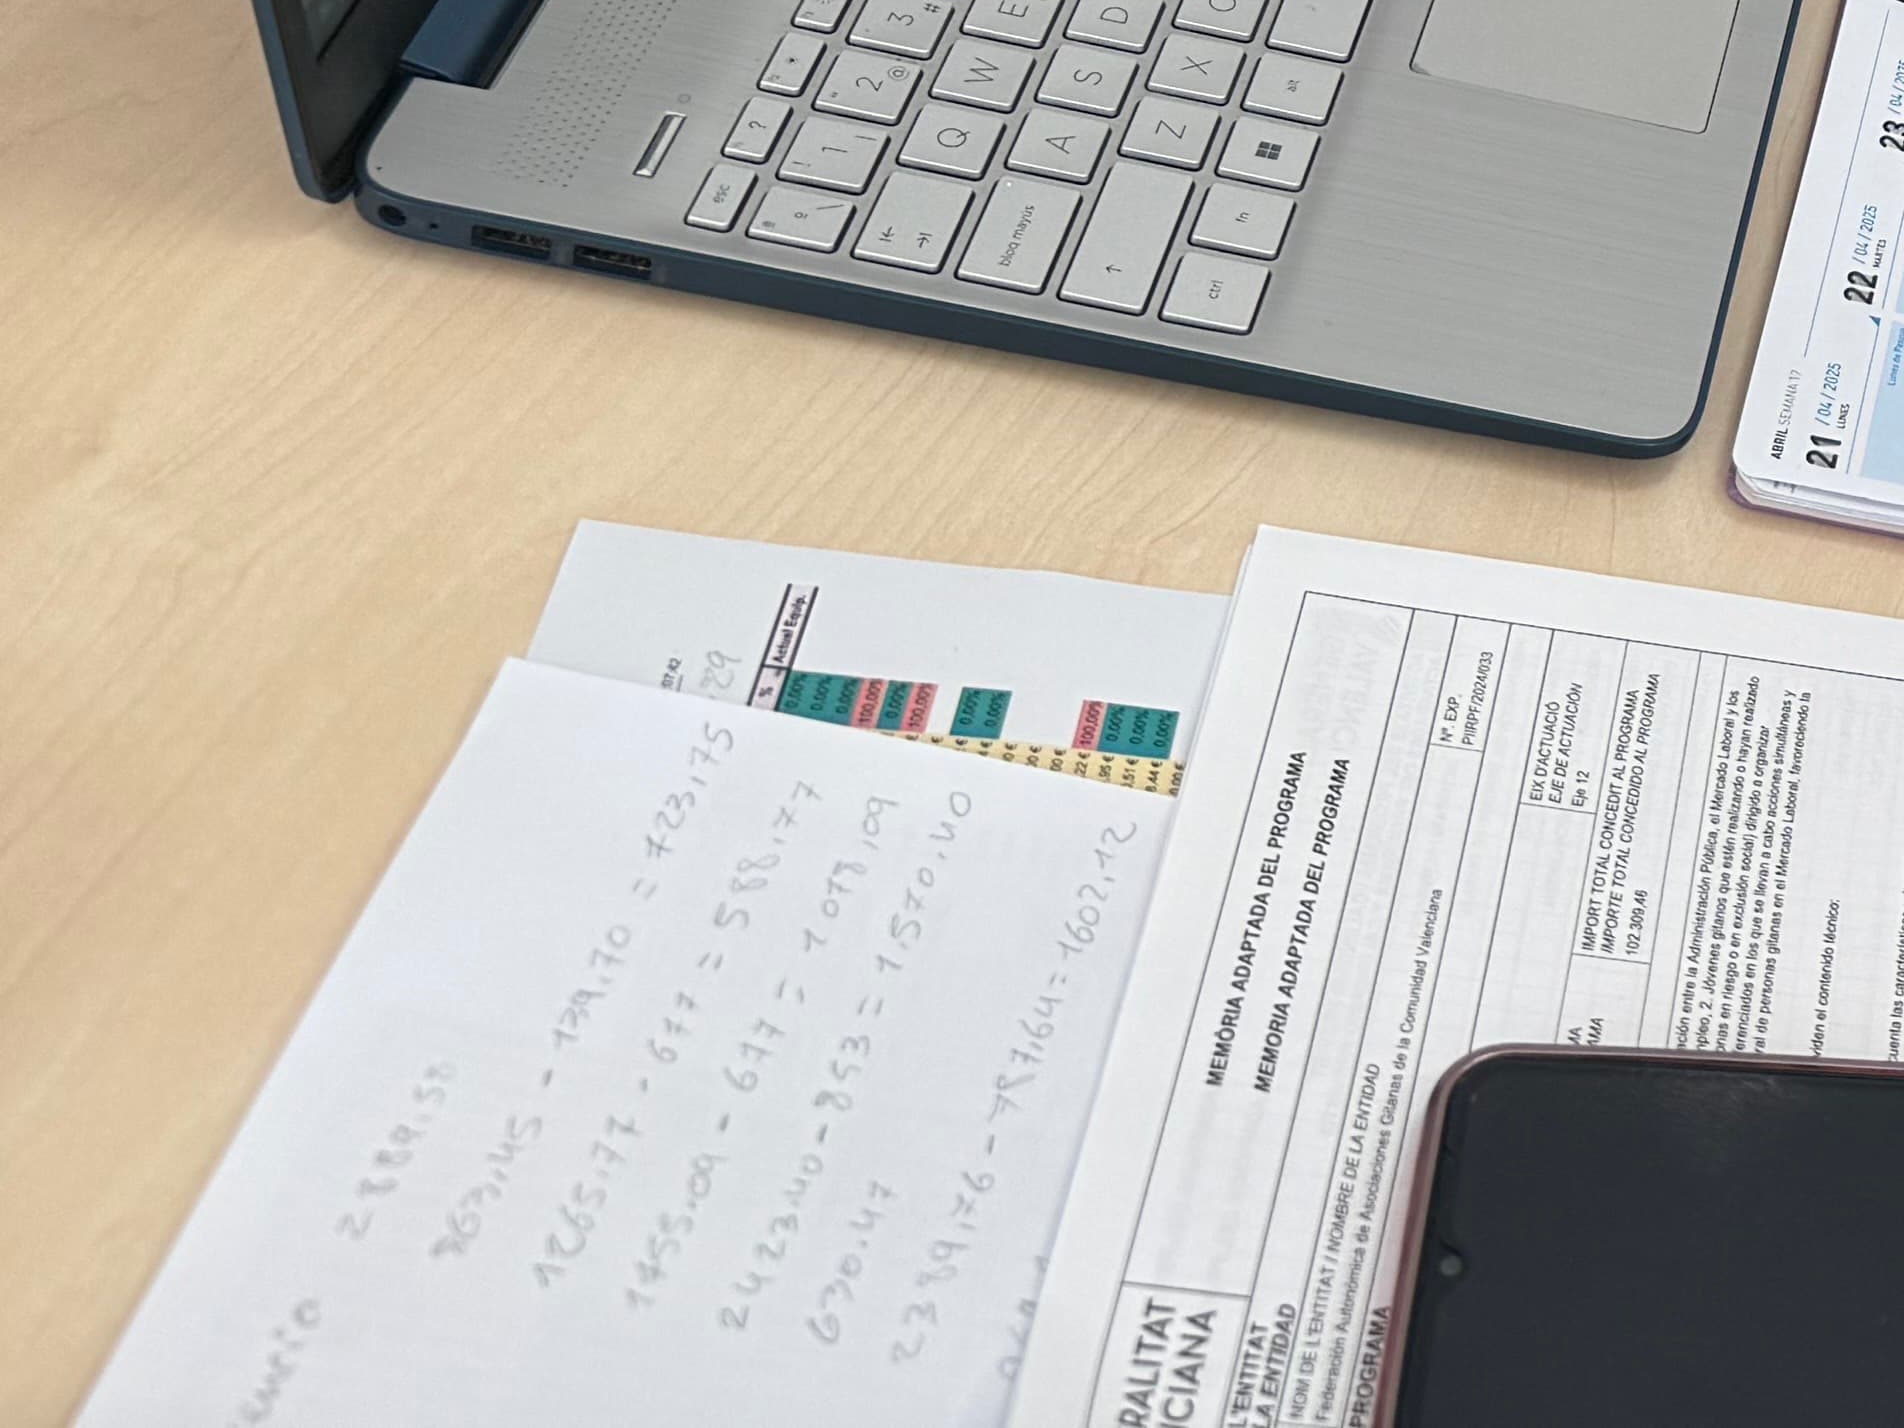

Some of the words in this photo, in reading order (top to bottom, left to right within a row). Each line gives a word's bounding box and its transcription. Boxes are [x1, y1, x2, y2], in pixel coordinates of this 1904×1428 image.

[937, 128, 970, 148] Q
[964, 57, 999, 82] W
[998, 0, 1029, 17] E
[1045, 136, 1076, 154] A
[1074, 69, 1102, 85] S
[1100, 7, 1128, 24] D
[1844, 271, 1878, 304] 22
[1788, 370, 1800, 380] 17
[1778, 384, 1797, 425] SEMANA
[1771, 429, 1788, 459] ABRIL
[1806, 435, 1841, 469] 21
[773, 630, 793, 662] Actual
[784, 595, 807, 626] Equip.
[1444, 697, 1459, 721] EXP.
[1462, 652, 1493, 745] PIIRPF/2024/033
[1558, 683, 1582, 757] ACTUACIÓN
[1636, 674, 1660, 745] PROGRAMA
[1534, 702, 1560, 776] D'ACTUACIÓ
[1614, 690, 1639, 761] PROGRAMA
[1717, 718, 1734, 759] Laboral
[1554, 758, 1568, 777] DE
[1576, 771, 1589, 783] 12
[1612, 765, 1626, 780] AL
[1634, 749, 1647, 764] AL
[1267, 752, 1306, 848] PROGRAMA
[1312, 760, 1349, 856] PROGRAMA
[1529, 780, 1545, 801] EIX
[1548, 779, 1564, 803] EJE
[1571, 789, 1588, 807] Eje
[1620, 766, 1644, 843] CONCEDIDO
[1710, 762, 1728, 811] Mercado
[1600, 783, 1622, 849] CONCEDIT
[1709, 814, 1720, 824] el
[1257, 854, 1280, 887] DEL
[1591, 854, 1610, 894] TOTAL
[1612, 848, 1630, 887] TOTAL
[1700, 829, 1720, 873] Pública,
[1303, 862, 1325, 894] DEL
[1232, 893, 1270, 992] ADAPTADA
[1416, 890, 1442, 956] Valenciana
[1582, 898, 1602, 951] IMPORT
[1601, 891, 1623, 953] IMPORTE
[1626, 890, 1647, 954] 102.309,46
[1687, 877, 1711, 964] Administración
[1278, 900, 1316, 998] ADAPTADA
[1685, 967, 1698, 977] la
[1400, 960, 1427, 1033] Comunidad
[1682, 982, 1700, 1013] entre
[1206, 997, 1244, 1086] MEMÒRIA
[1254, 1004, 1290, 1092] MEMORIA
[1393, 1053, 1407, 1070] de
[1396, 1038, 1410, 1049] la
[1353, 1064, 1380, 1131] ENTIDAD
[1379, 1074, 1403, 1126] Gitanas
[1342, 1157, 1360, 1180] DE
[1349, 1135, 1364, 1154] LA
[1358, 1130, 1391, 1221] Asociaciones
[1326, 1183, 1354, 1252] NOMBRE
[1355, 1225, 1370, 1243] de
[1305, 1266, 1334, 1347] L'ENTITAT
[1334, 1247, 1366, 1333] Autonómica
[1260, 1304, 1295, 1398] ENTIDAD
[1299, 1352, 1317, 1375] DE
[1289, 1379, 1310, 1420] NOM
[1315, 1337, 1345, 1422] Federación
